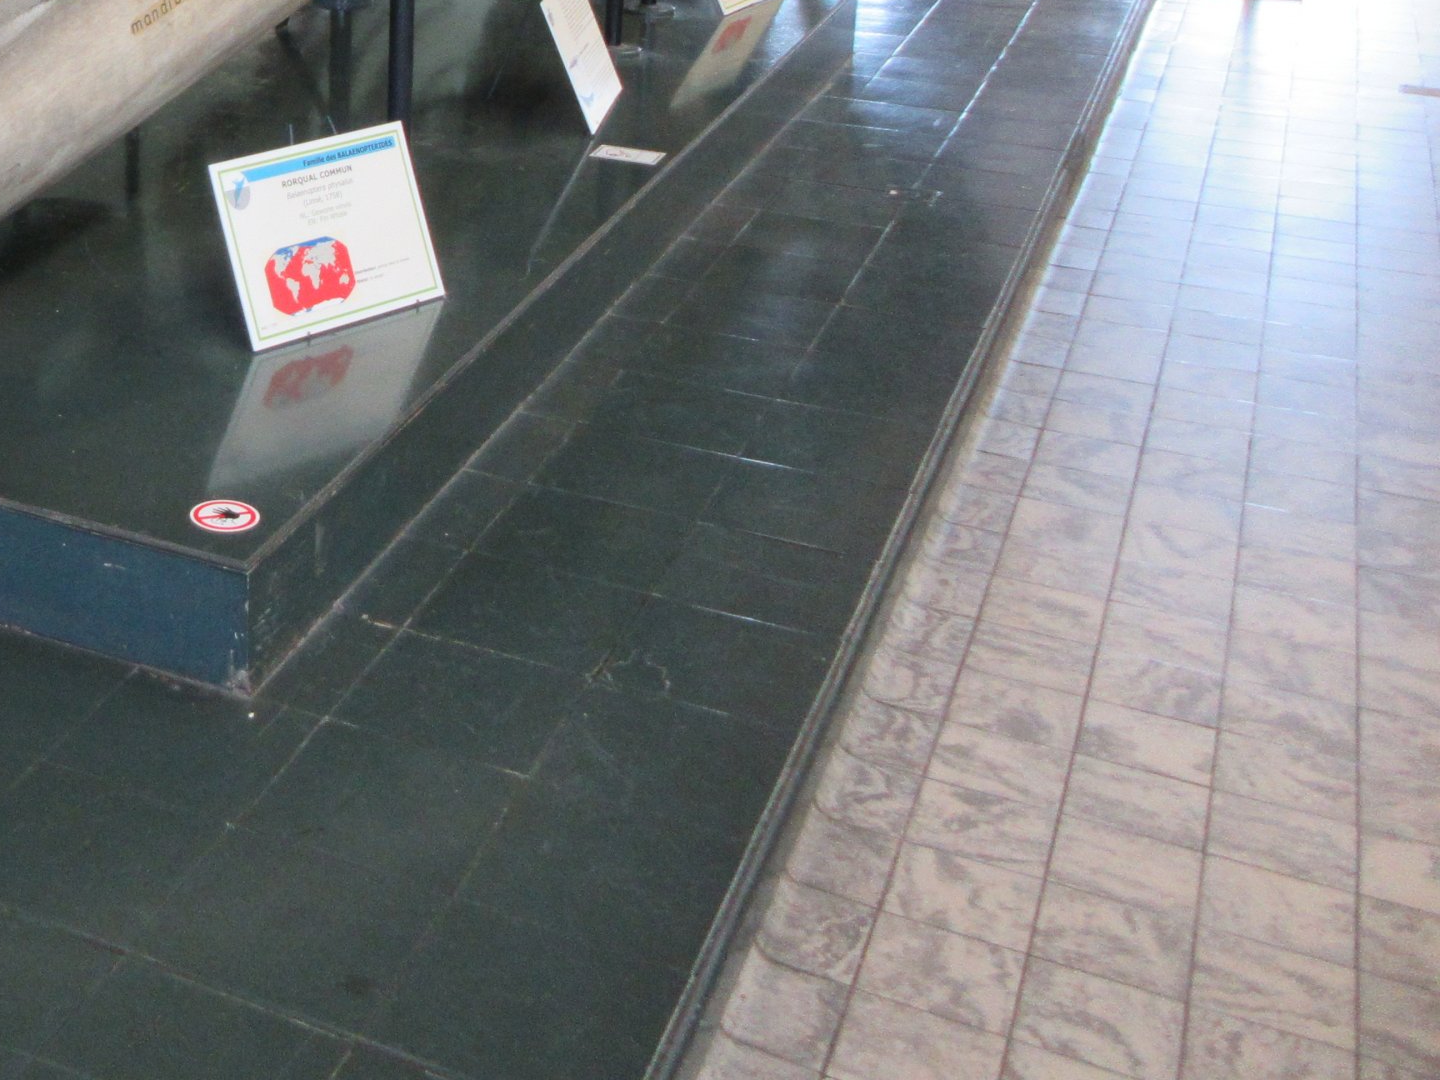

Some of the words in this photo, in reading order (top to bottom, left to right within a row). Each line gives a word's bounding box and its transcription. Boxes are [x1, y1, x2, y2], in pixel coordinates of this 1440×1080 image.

[303, 156, 325, 167] Famille
[325, 153, 337, 162] des
[281, 173, 318, 189] RORQUAL
[320, 165, 353, 179] COMMUN
